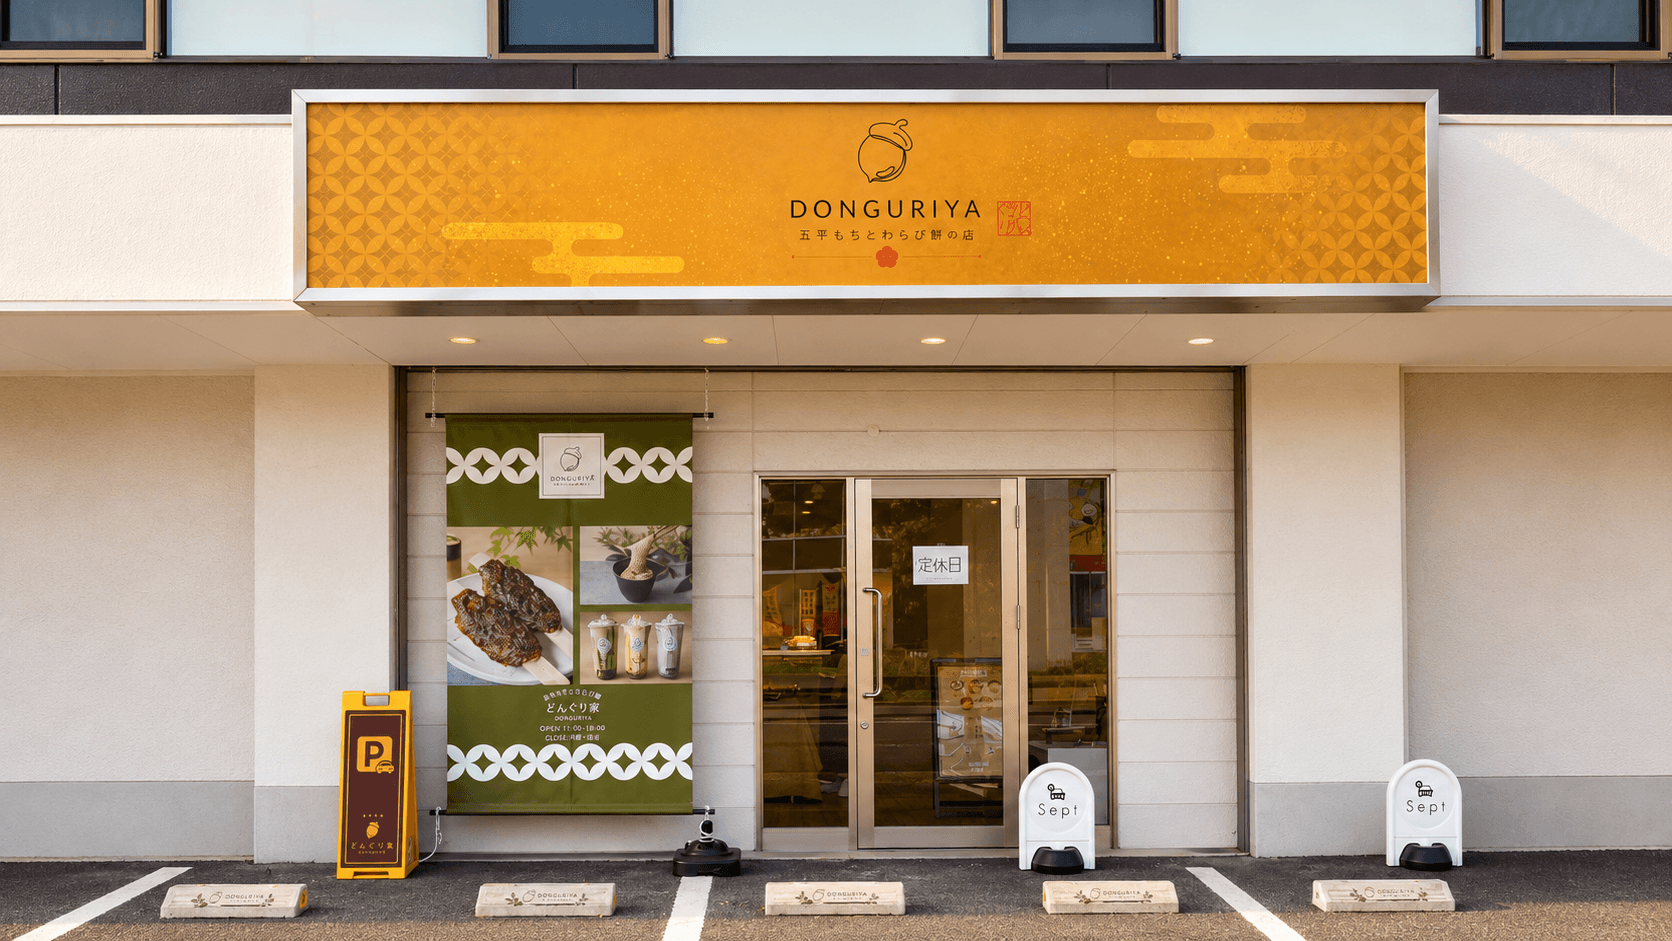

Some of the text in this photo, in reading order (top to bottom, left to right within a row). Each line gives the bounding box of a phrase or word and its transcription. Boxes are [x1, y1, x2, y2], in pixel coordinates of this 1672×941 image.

[790, 199, 981, 219] DONGURIYA
[799, 229, 975, 241] 五平もちとわらび餅の店
[917, 556, 961, 573] 定休日
[546, 702, 600, 713] どんぐり家
[364, 740, 385, 768] P
[1037, 802, 1078, 819] Sept
[1406, 799, 1446, 816] Sept
